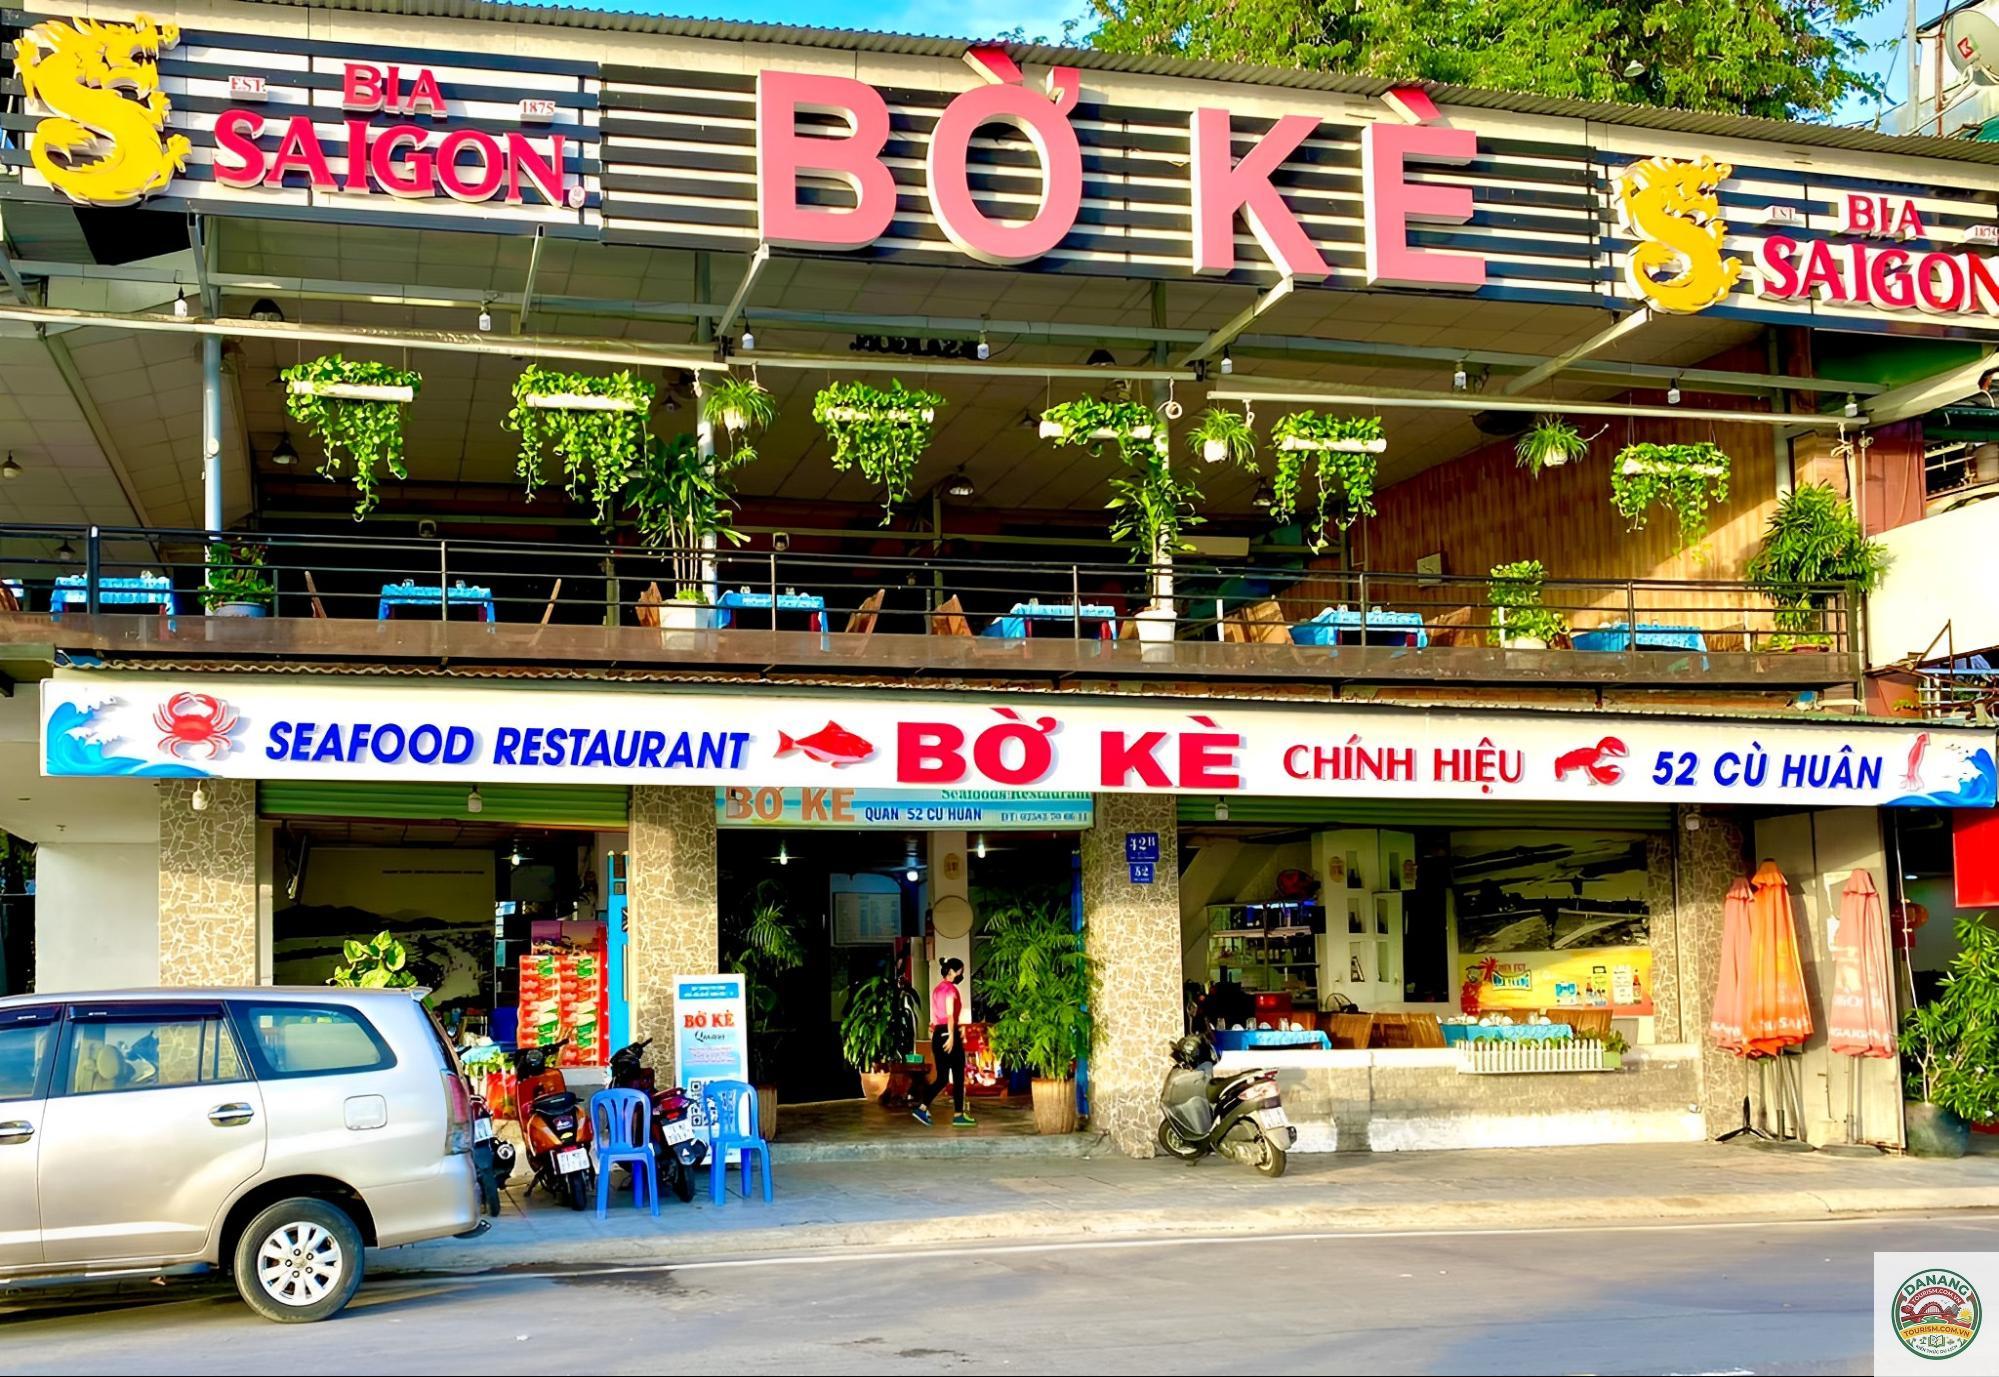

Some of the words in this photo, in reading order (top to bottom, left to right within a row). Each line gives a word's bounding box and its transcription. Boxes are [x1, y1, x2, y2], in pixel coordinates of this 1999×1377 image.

[343, 62, 448, 117] BIA
[522, 100, 556, 115] 1875
[212, 109, 566, 207] SAIGON
[756, 43, 1083, 266] BỜ
[1190, 84, 1488, 292] KÈ
[1847, 194, 1927, 236] BIA
[266, 720, 474, 766] SEAFOOD
[493, 726, 750, 769] RESTAURANT
[896, 707, 1057, 786] BỜ
[1100, 715, 1240, 789] KÈ
[1283, 734, 1415, 783] CHÍNH
[1433, 737, 1525, 793] HIỆU
[1652, 750, 1698, 787] 52
[1713, 742, 1769, 788] CÙ
[1779, 744, 1884, 789] HUÂN
[907, 806, 923, 820] 52
